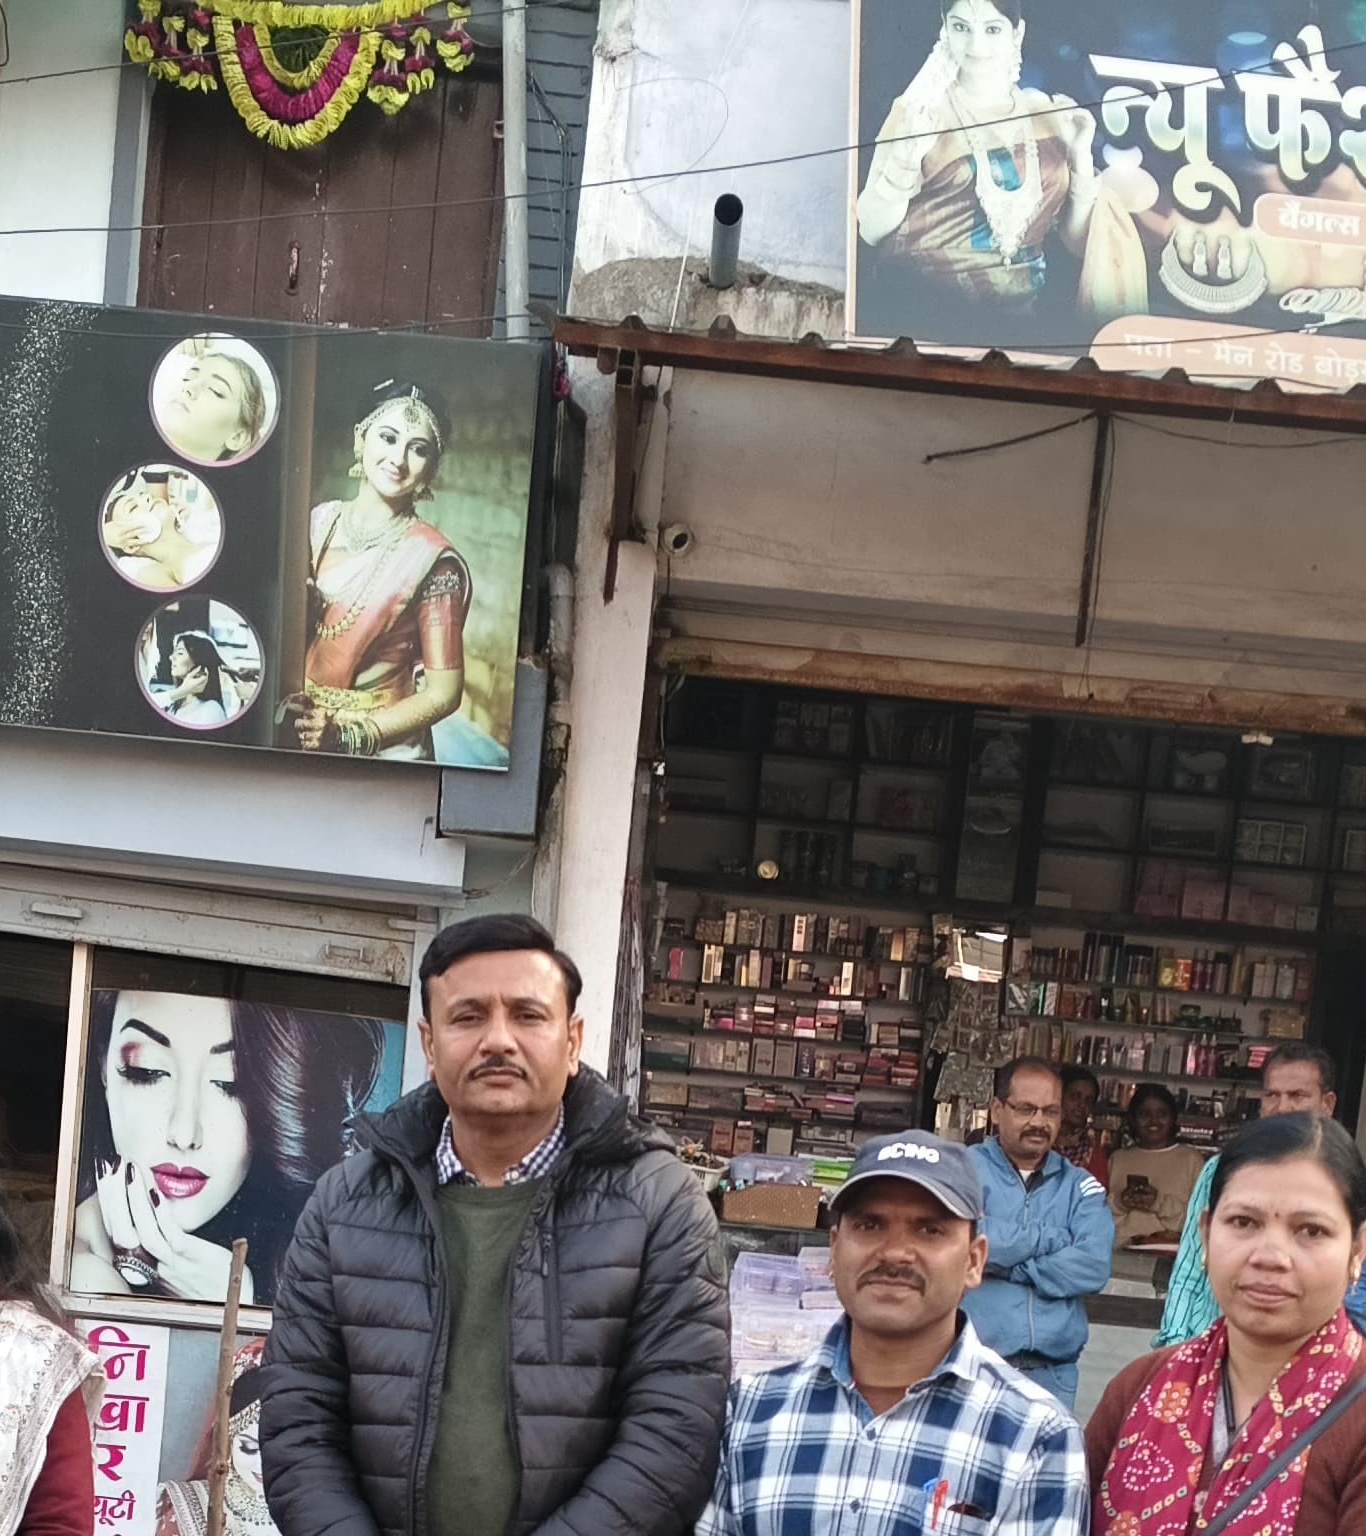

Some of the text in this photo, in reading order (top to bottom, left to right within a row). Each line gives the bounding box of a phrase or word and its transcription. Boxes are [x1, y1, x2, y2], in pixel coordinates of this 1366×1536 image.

[1090, 53, 1242, 216] न्यू
[1124, 333, 1172, 359] पता
[1212, 339, 1254, 369] मेन
[1265, 341, 1305, 374] रोड
[93, 1489, 137, 1526] यूटी
